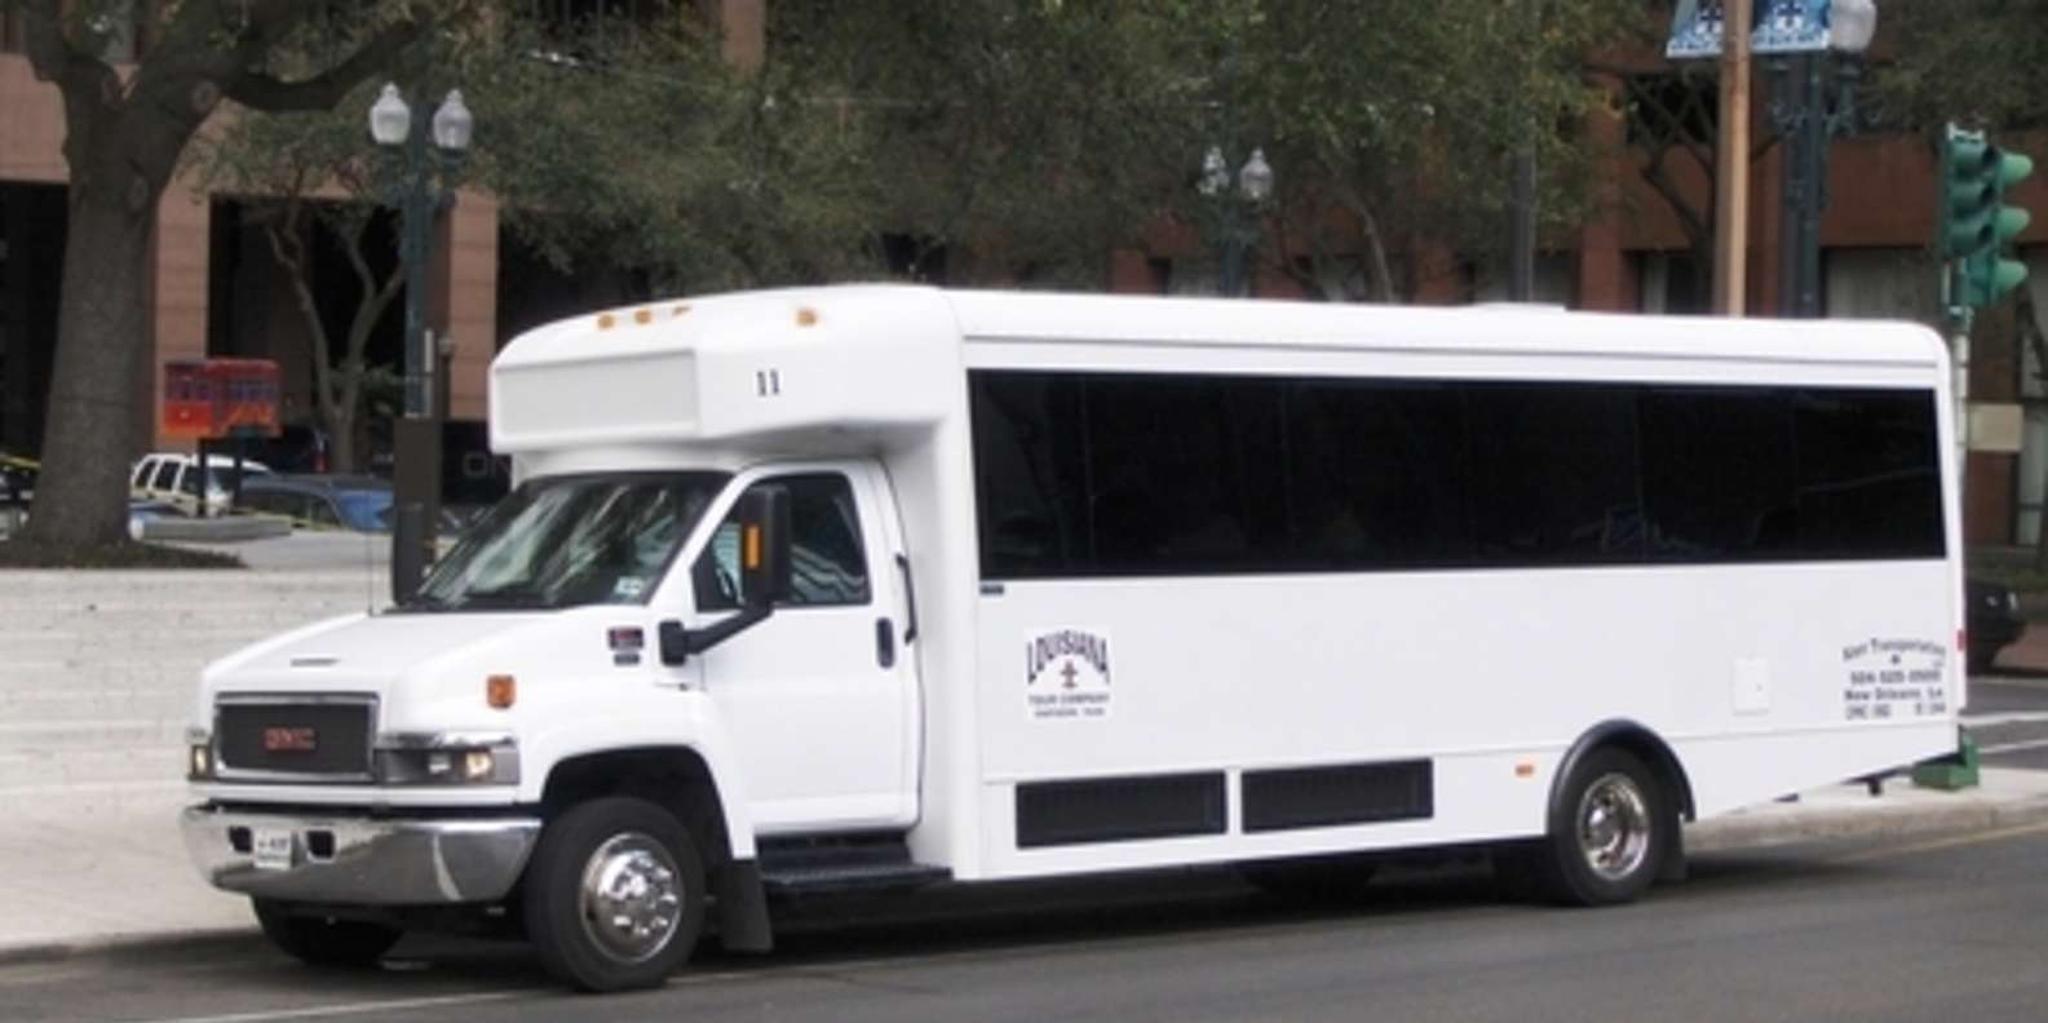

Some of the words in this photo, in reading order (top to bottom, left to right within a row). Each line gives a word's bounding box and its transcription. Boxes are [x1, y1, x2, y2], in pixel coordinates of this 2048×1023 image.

[757, 369, 780, 397] 11
[1026, 629, 1110, 685] LOUISIANA
[1844, 690, 1870, 700] New
[264, 727, 316, 750] GMC
